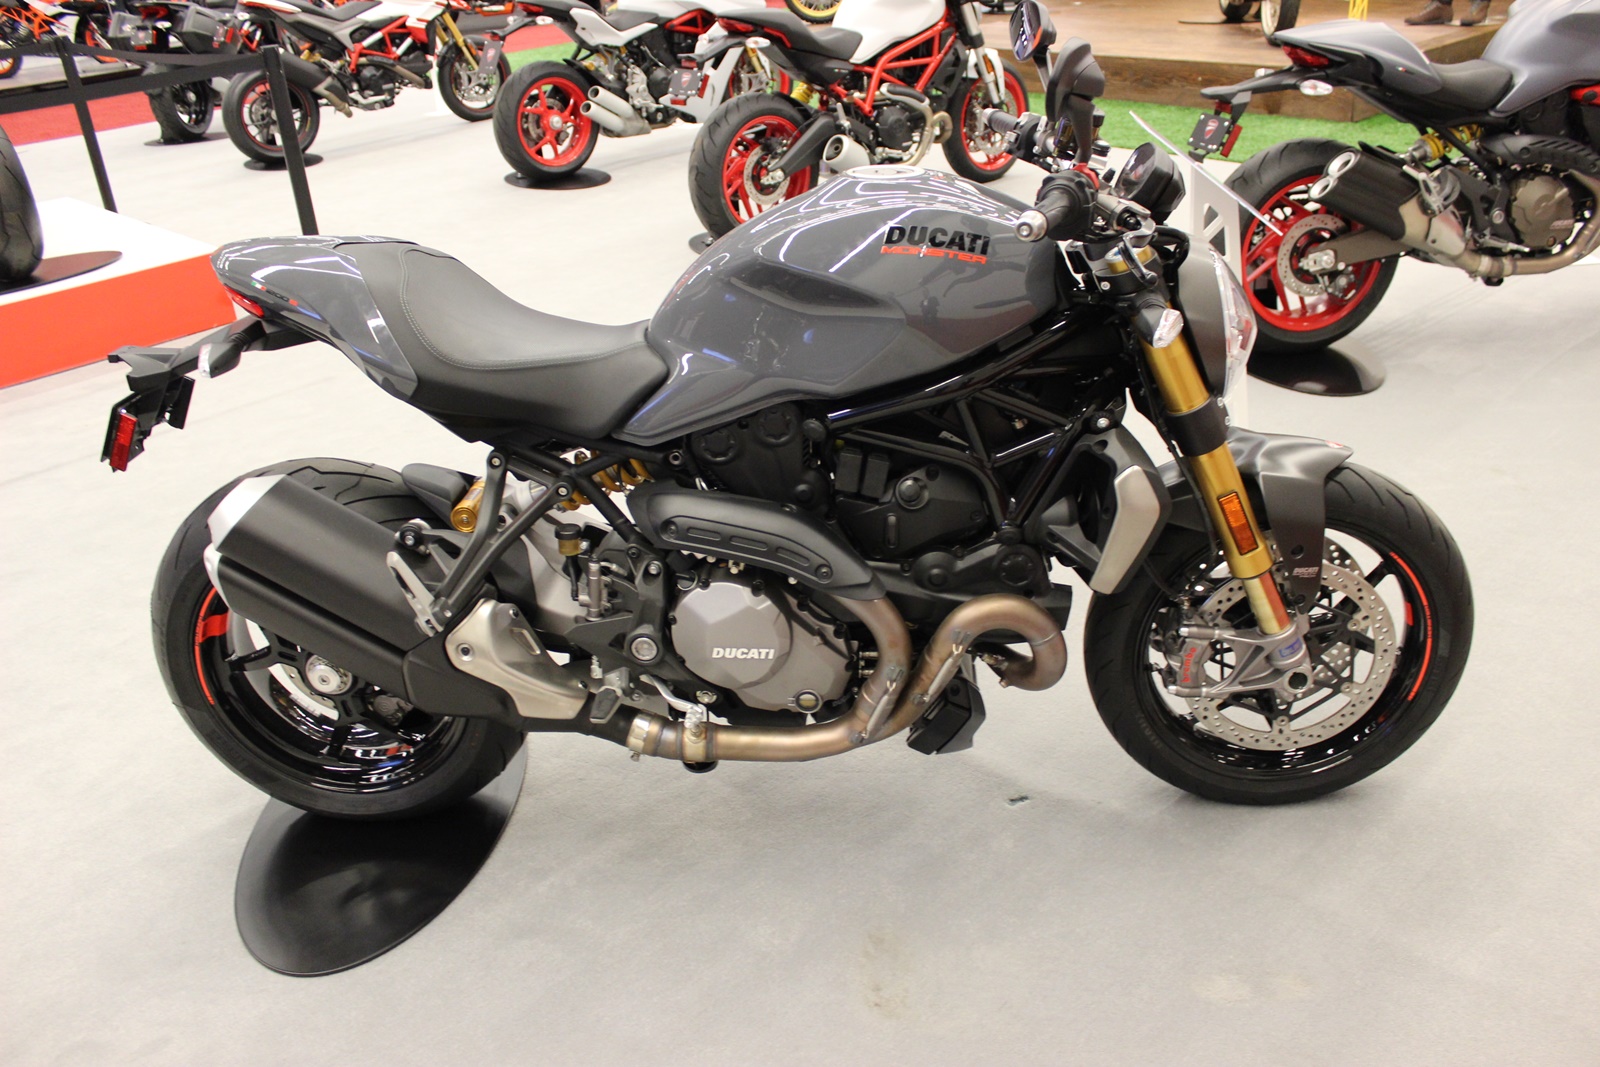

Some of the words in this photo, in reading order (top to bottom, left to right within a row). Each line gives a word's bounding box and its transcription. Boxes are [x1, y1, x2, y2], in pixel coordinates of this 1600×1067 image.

[884, 225, 991, 256] DUCATI
[711, 647, 775, 660] DUCATI
[1181, 647, 1198, 683] brembo
